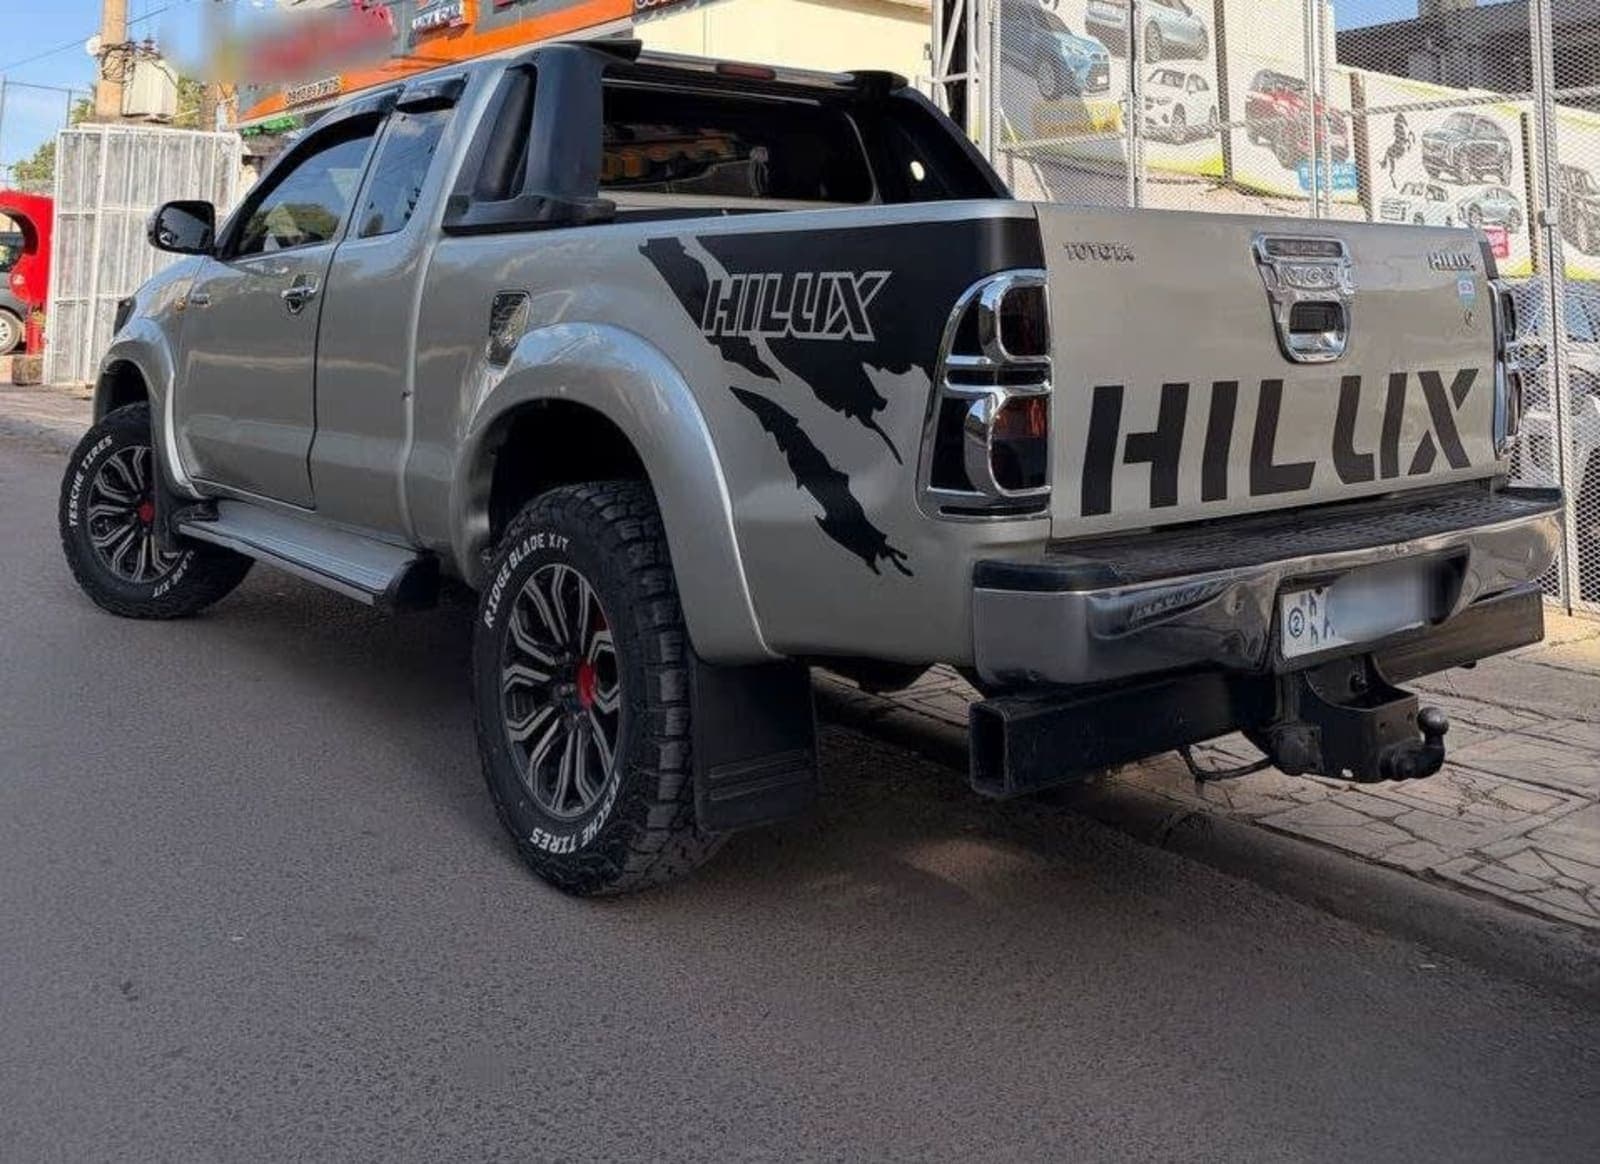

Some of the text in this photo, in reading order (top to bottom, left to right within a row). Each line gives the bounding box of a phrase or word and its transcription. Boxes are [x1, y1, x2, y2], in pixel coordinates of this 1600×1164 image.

[701, 271, 892, 342] HILUX
[81, 435, 113, 470] TIRES
[1080, 368, 1479, 517] HILUX
[484, 561, 511, 629] RIDGE
[509, 533, 545, 570] BLADE
[529, 827, 577, 854] TIRES
